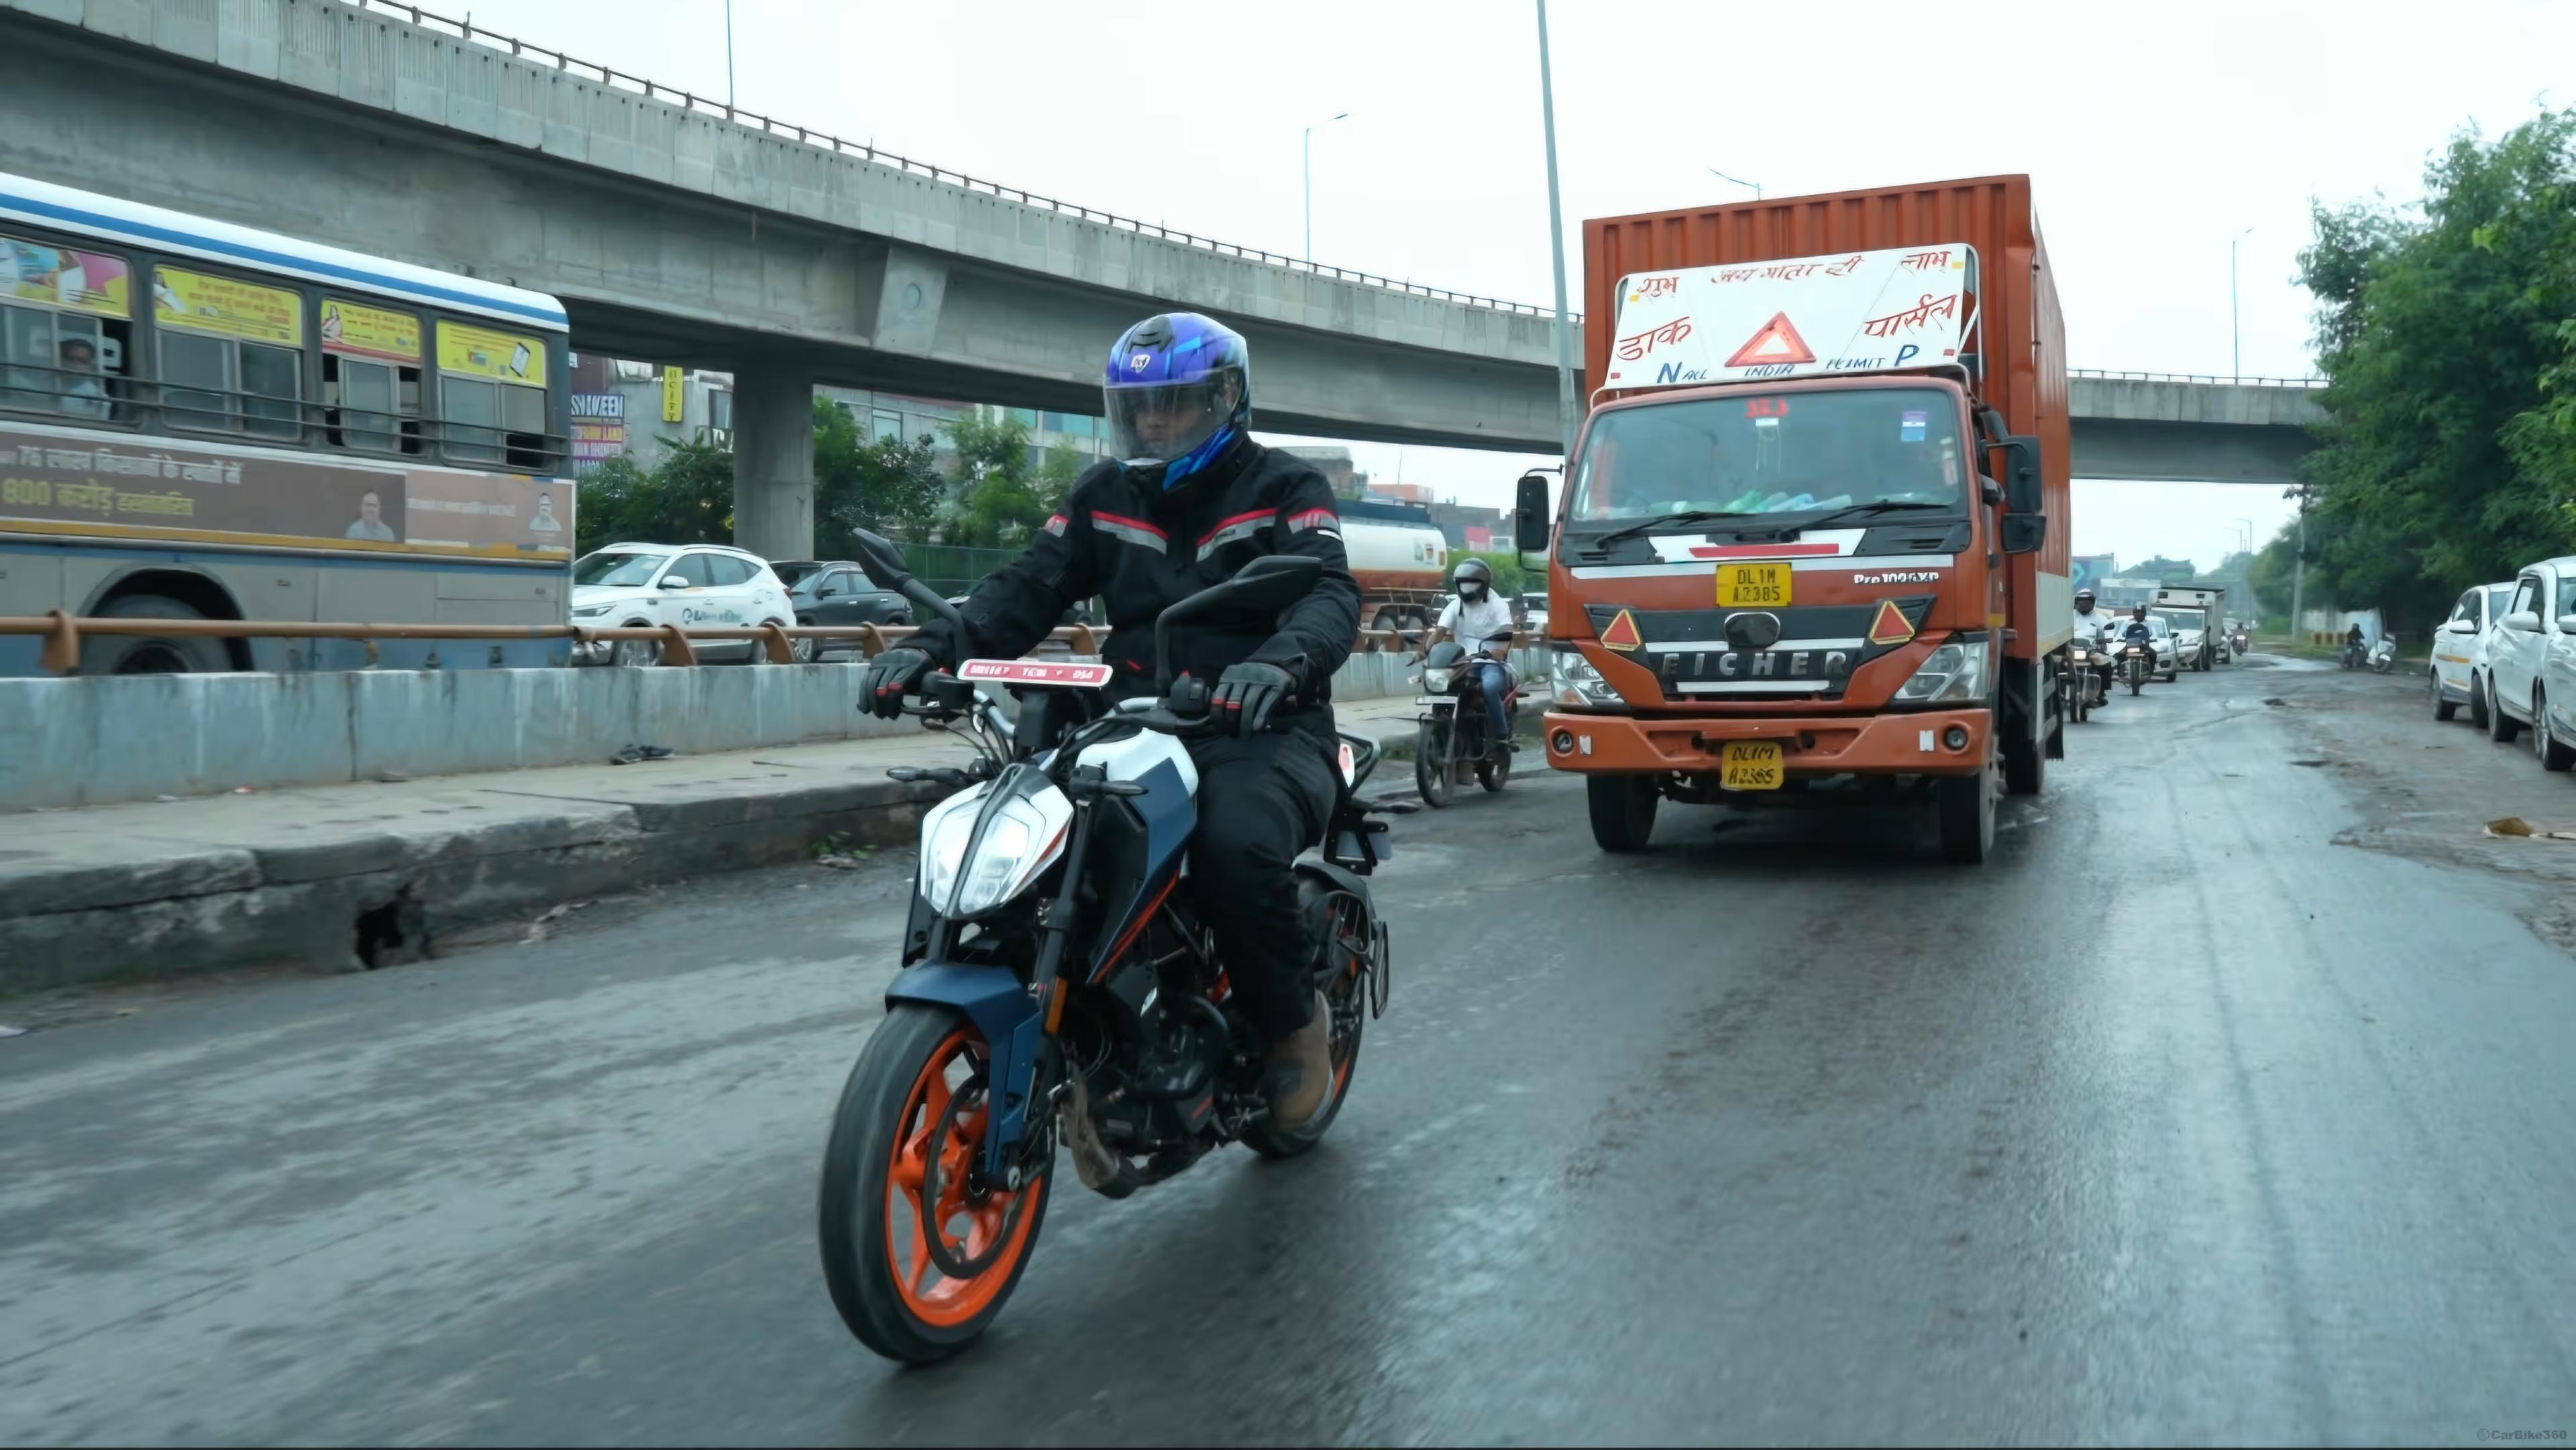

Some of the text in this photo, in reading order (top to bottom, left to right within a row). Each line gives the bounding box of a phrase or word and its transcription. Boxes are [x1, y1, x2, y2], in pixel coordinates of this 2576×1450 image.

[1864, 294, 1957, 338] पार्सल
[1617, 316, 1692, 361] डाक
[1657, 361, 1682, 384] N
[1744, 364, 1796, 377] INDIA
[1894, 344, 1920, 367] P
[1662, 651, 1847, 676] EICHER
